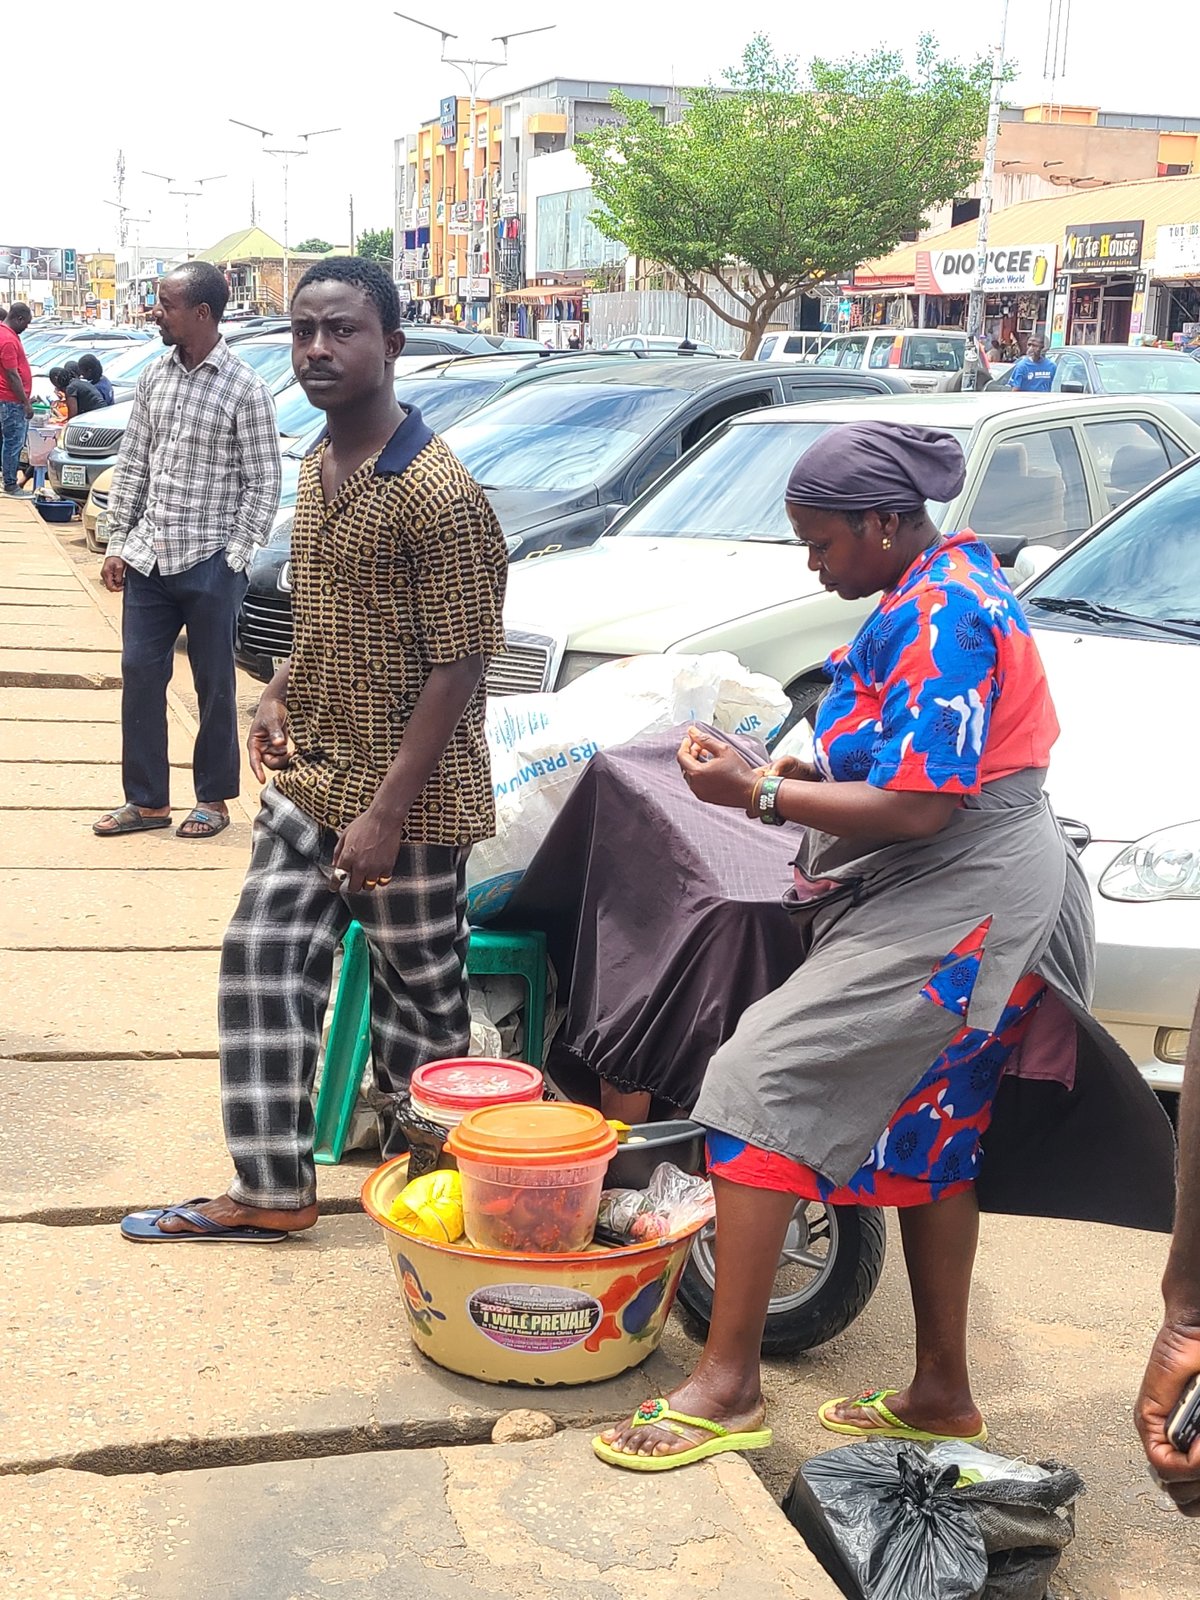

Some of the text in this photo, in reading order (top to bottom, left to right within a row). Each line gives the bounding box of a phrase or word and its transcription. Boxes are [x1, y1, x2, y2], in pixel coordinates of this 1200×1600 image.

[1100, 234, 1138, 258] House
[981, 274, 1025, 285] Fashion World
[493, 752, 568, 798] PREMIUM
[759, 794, 768, 810] GOOD
[492, 1313, 528, 1330] WILL
[499, 1326, 516, 1334] Mighty
